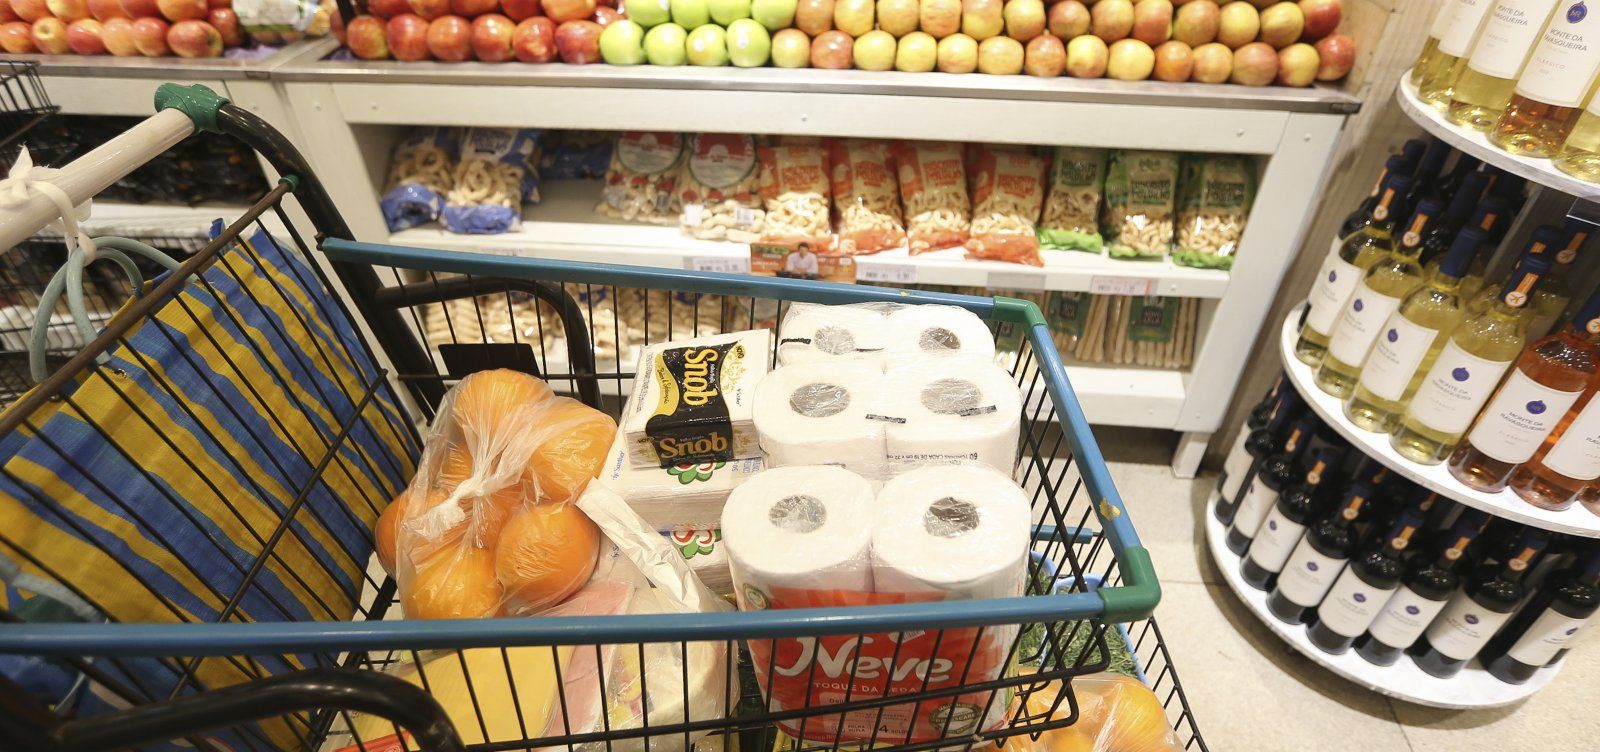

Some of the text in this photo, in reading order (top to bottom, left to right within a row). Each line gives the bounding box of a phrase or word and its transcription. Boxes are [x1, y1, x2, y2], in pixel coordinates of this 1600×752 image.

[683, 348, 718, 406] Snob
[658, 432, 728, 459] Snob
[969, 452, 978, 460] 60
[774, 636, 953, 683] Neve
[814, 682, 857, 692] TOQUE
[861, 684, 879, 693] DA
[878, 724, 889, 733] 4
